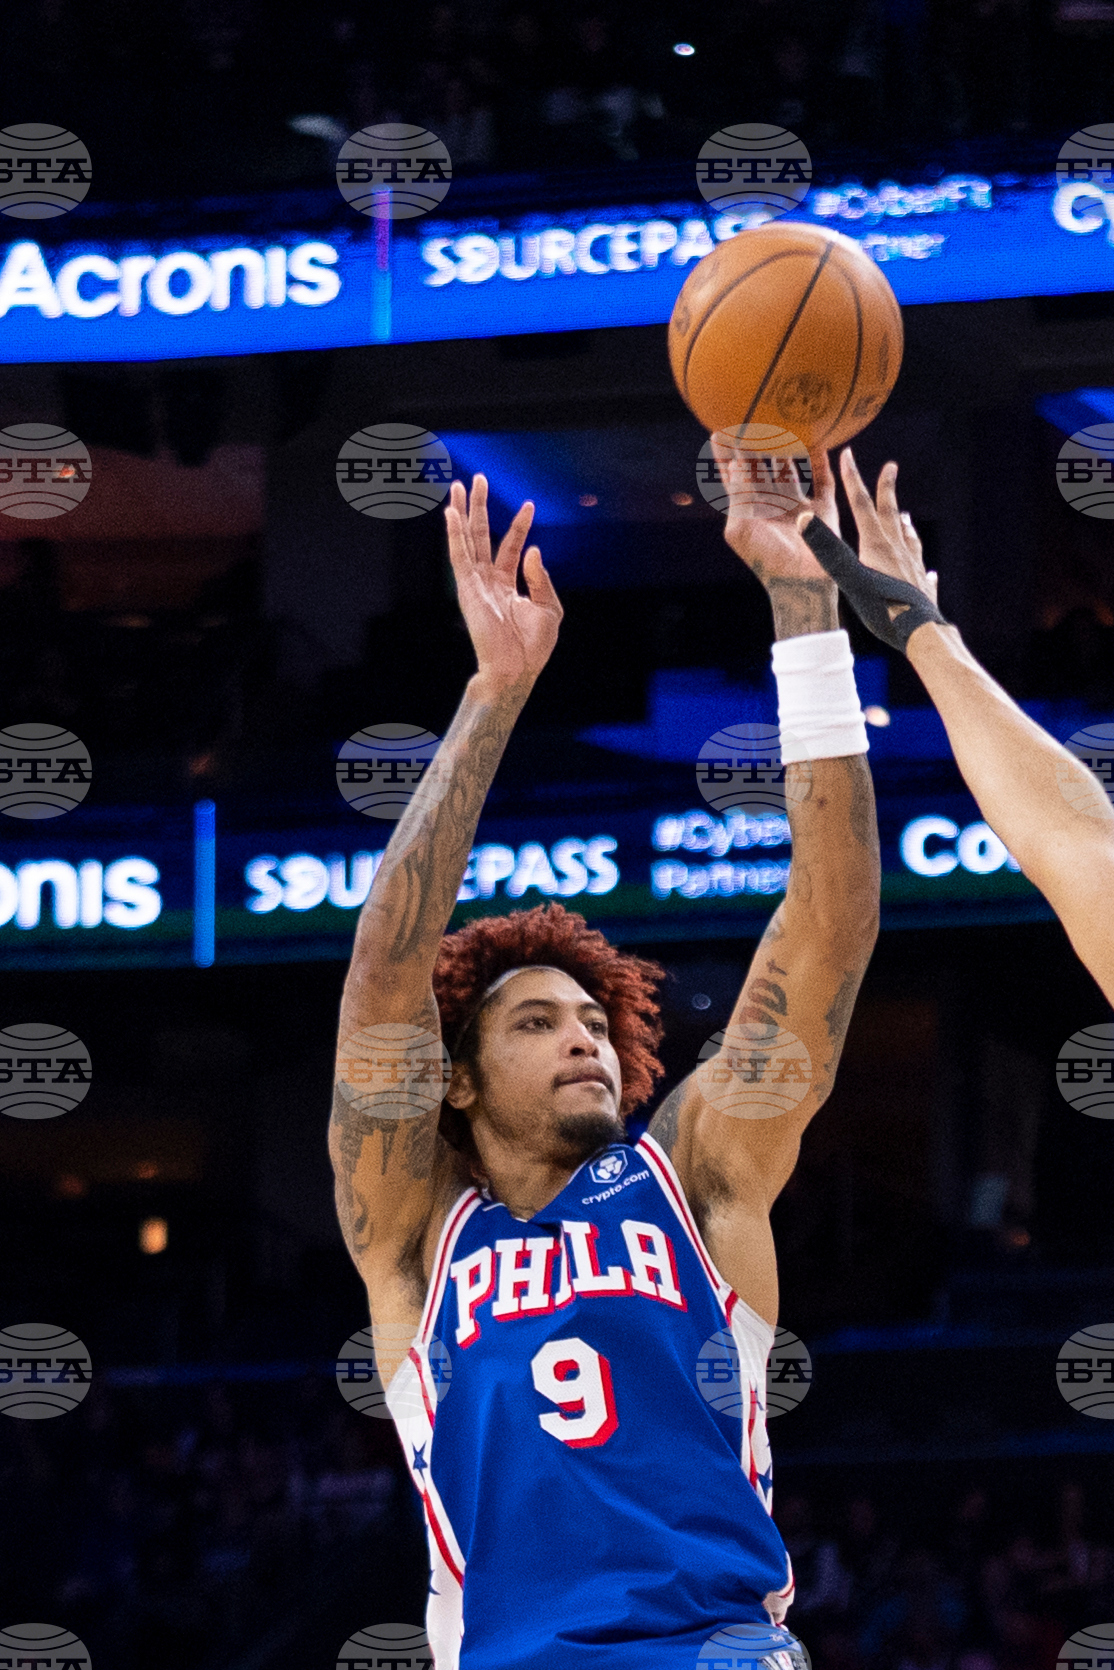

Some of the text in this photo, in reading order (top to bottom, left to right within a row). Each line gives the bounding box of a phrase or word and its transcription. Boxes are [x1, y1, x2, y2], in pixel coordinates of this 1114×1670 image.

[0, 240, 341, 318] Acronis
[582, 1169, 650, 1205] crypto.com
[531, 1337, 619, 1449] 9
